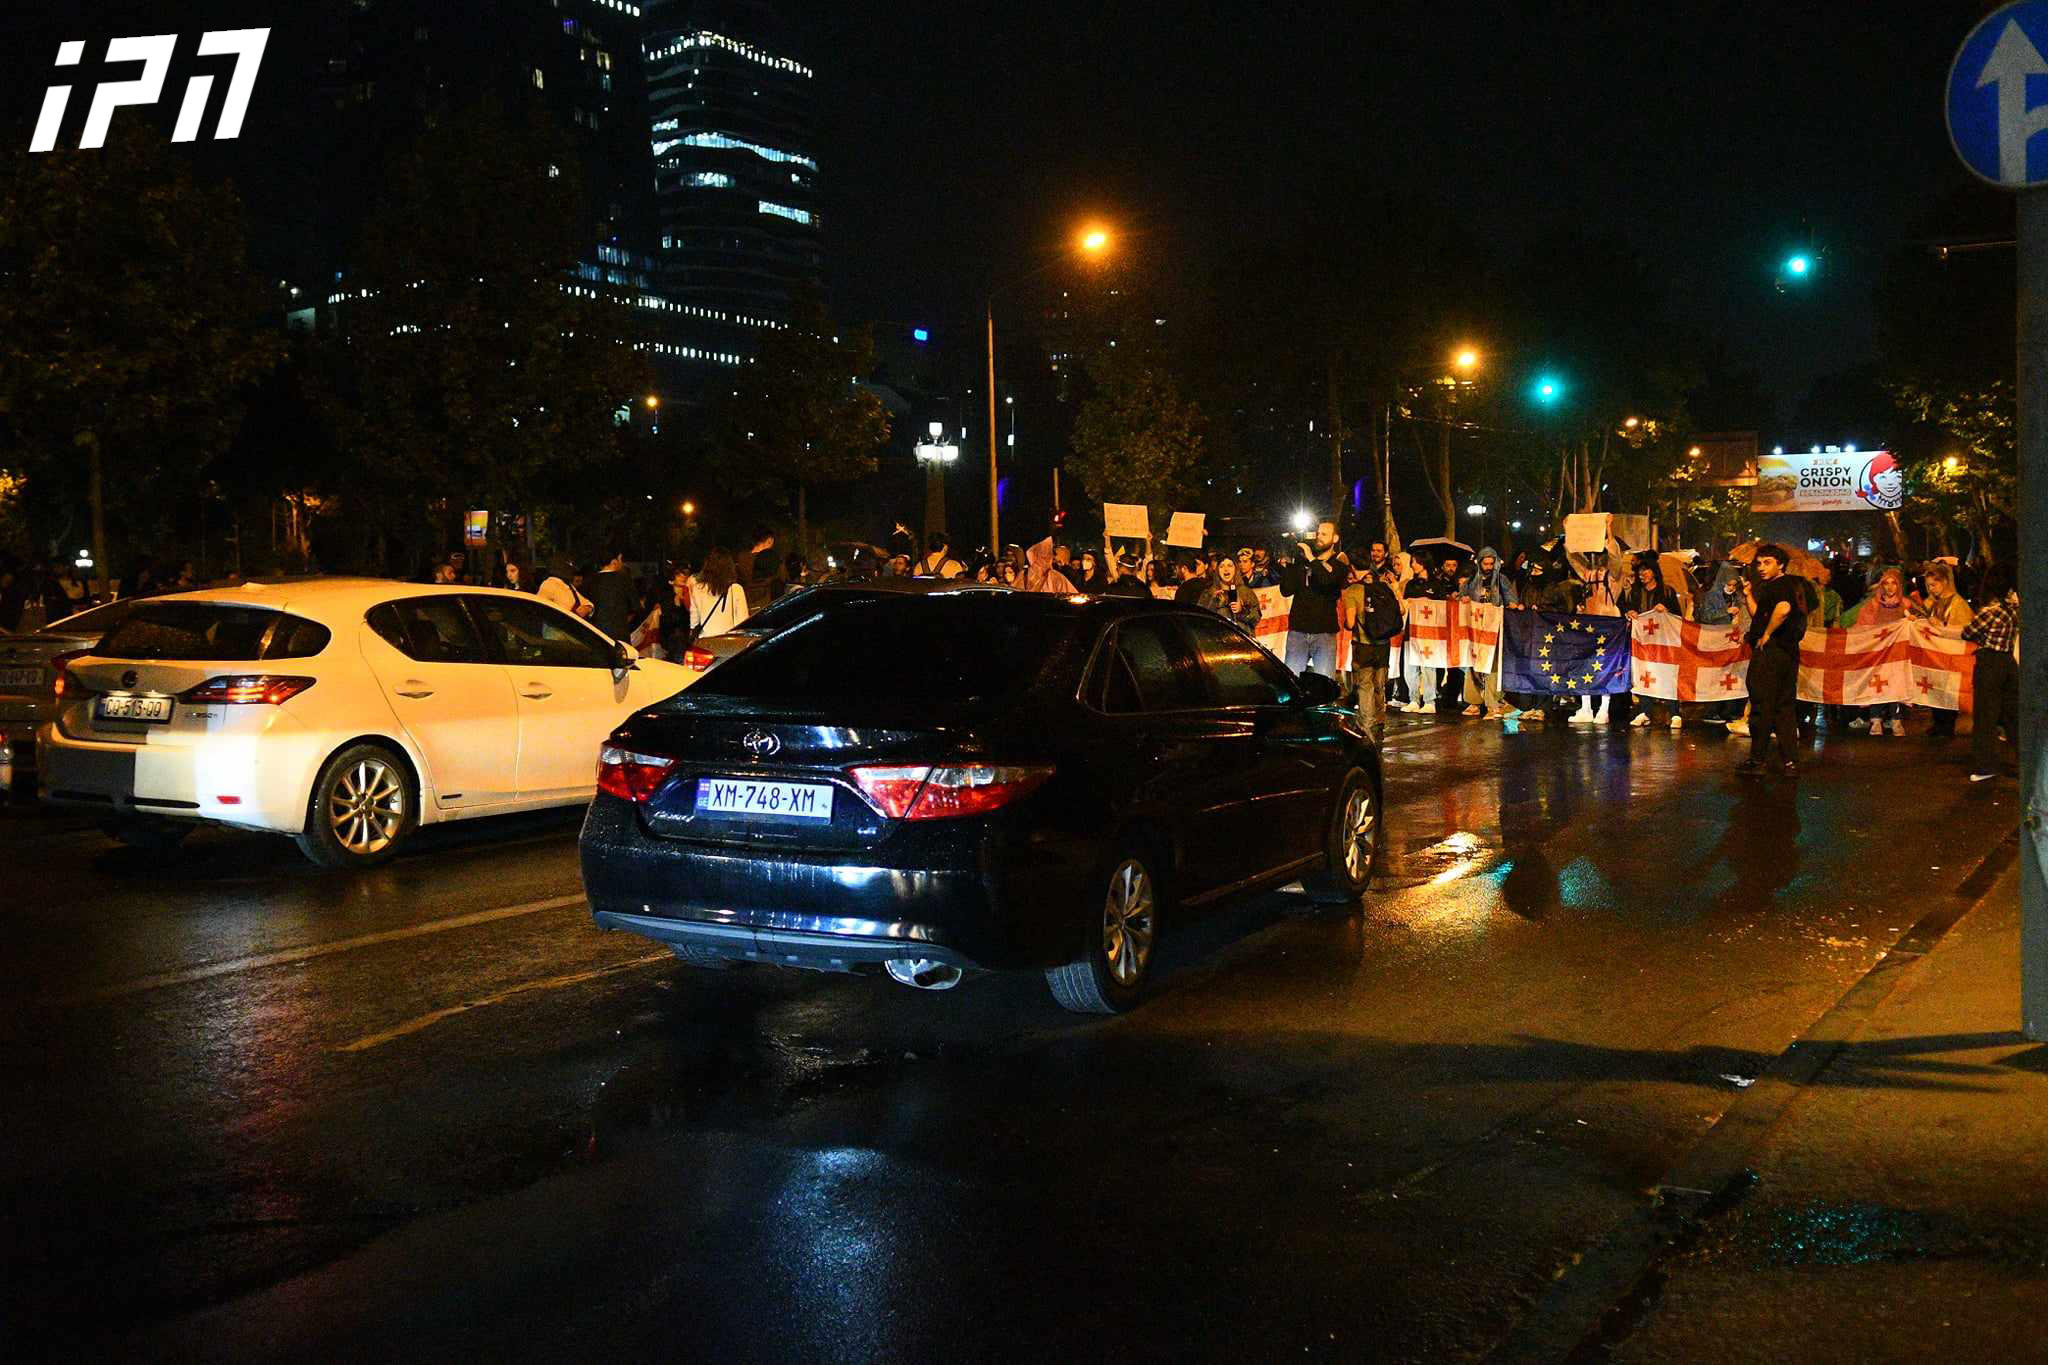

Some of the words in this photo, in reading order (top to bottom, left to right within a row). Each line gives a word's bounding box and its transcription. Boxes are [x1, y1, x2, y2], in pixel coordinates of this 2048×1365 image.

[1800, 466, 1851, 478] CRISPY
[1800, 476, 1852, 488] ONION
[712, 783, 815, 812] XM-748-XM
